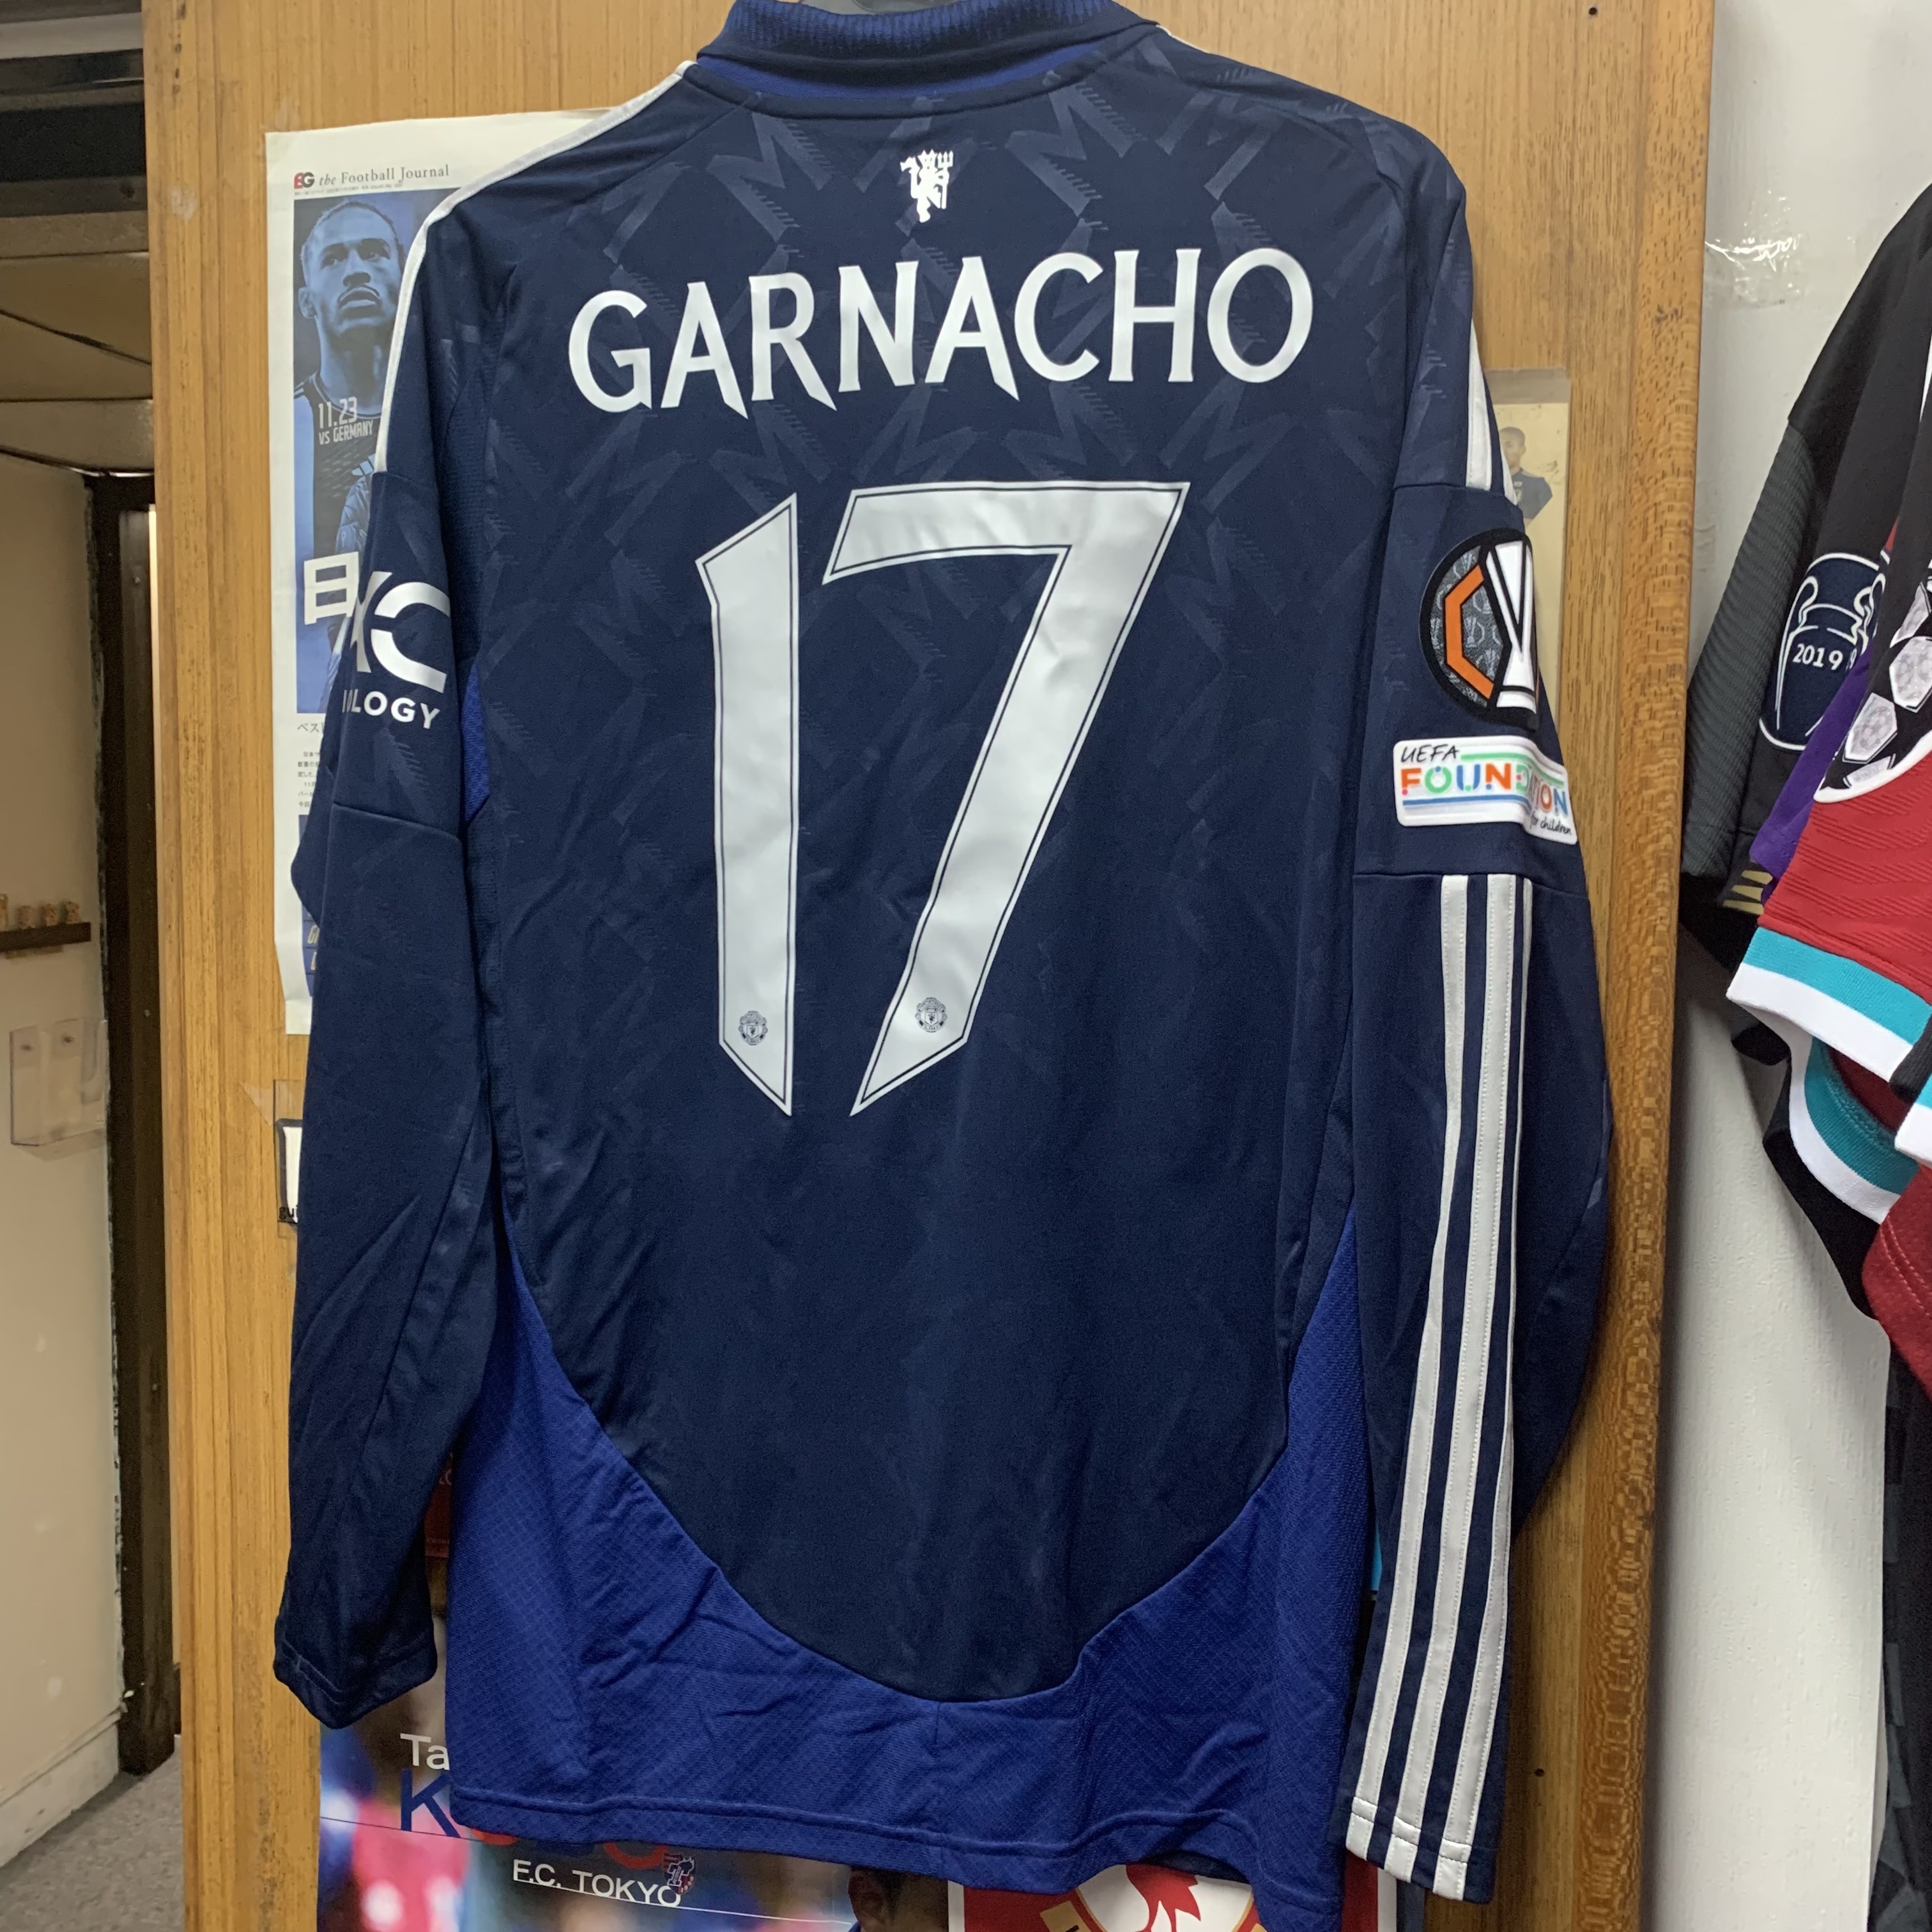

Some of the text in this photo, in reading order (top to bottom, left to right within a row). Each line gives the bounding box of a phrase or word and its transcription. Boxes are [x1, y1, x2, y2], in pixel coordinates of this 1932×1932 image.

[319, 173, 335, 186] the
[341, 167, 394, 184] Football
[399, 164, 449, 183] Journal
[568, 248, 1313, 419] GARNACHO
[318, 395, 357, 429] 11.23
[318, 419, 373, 445] VS GERMANY
[1401, 744, 1459, 763] UEFA
[696, 480, 1190, 1116] 17
[572, 1870, 682, 1907] TOKYO
